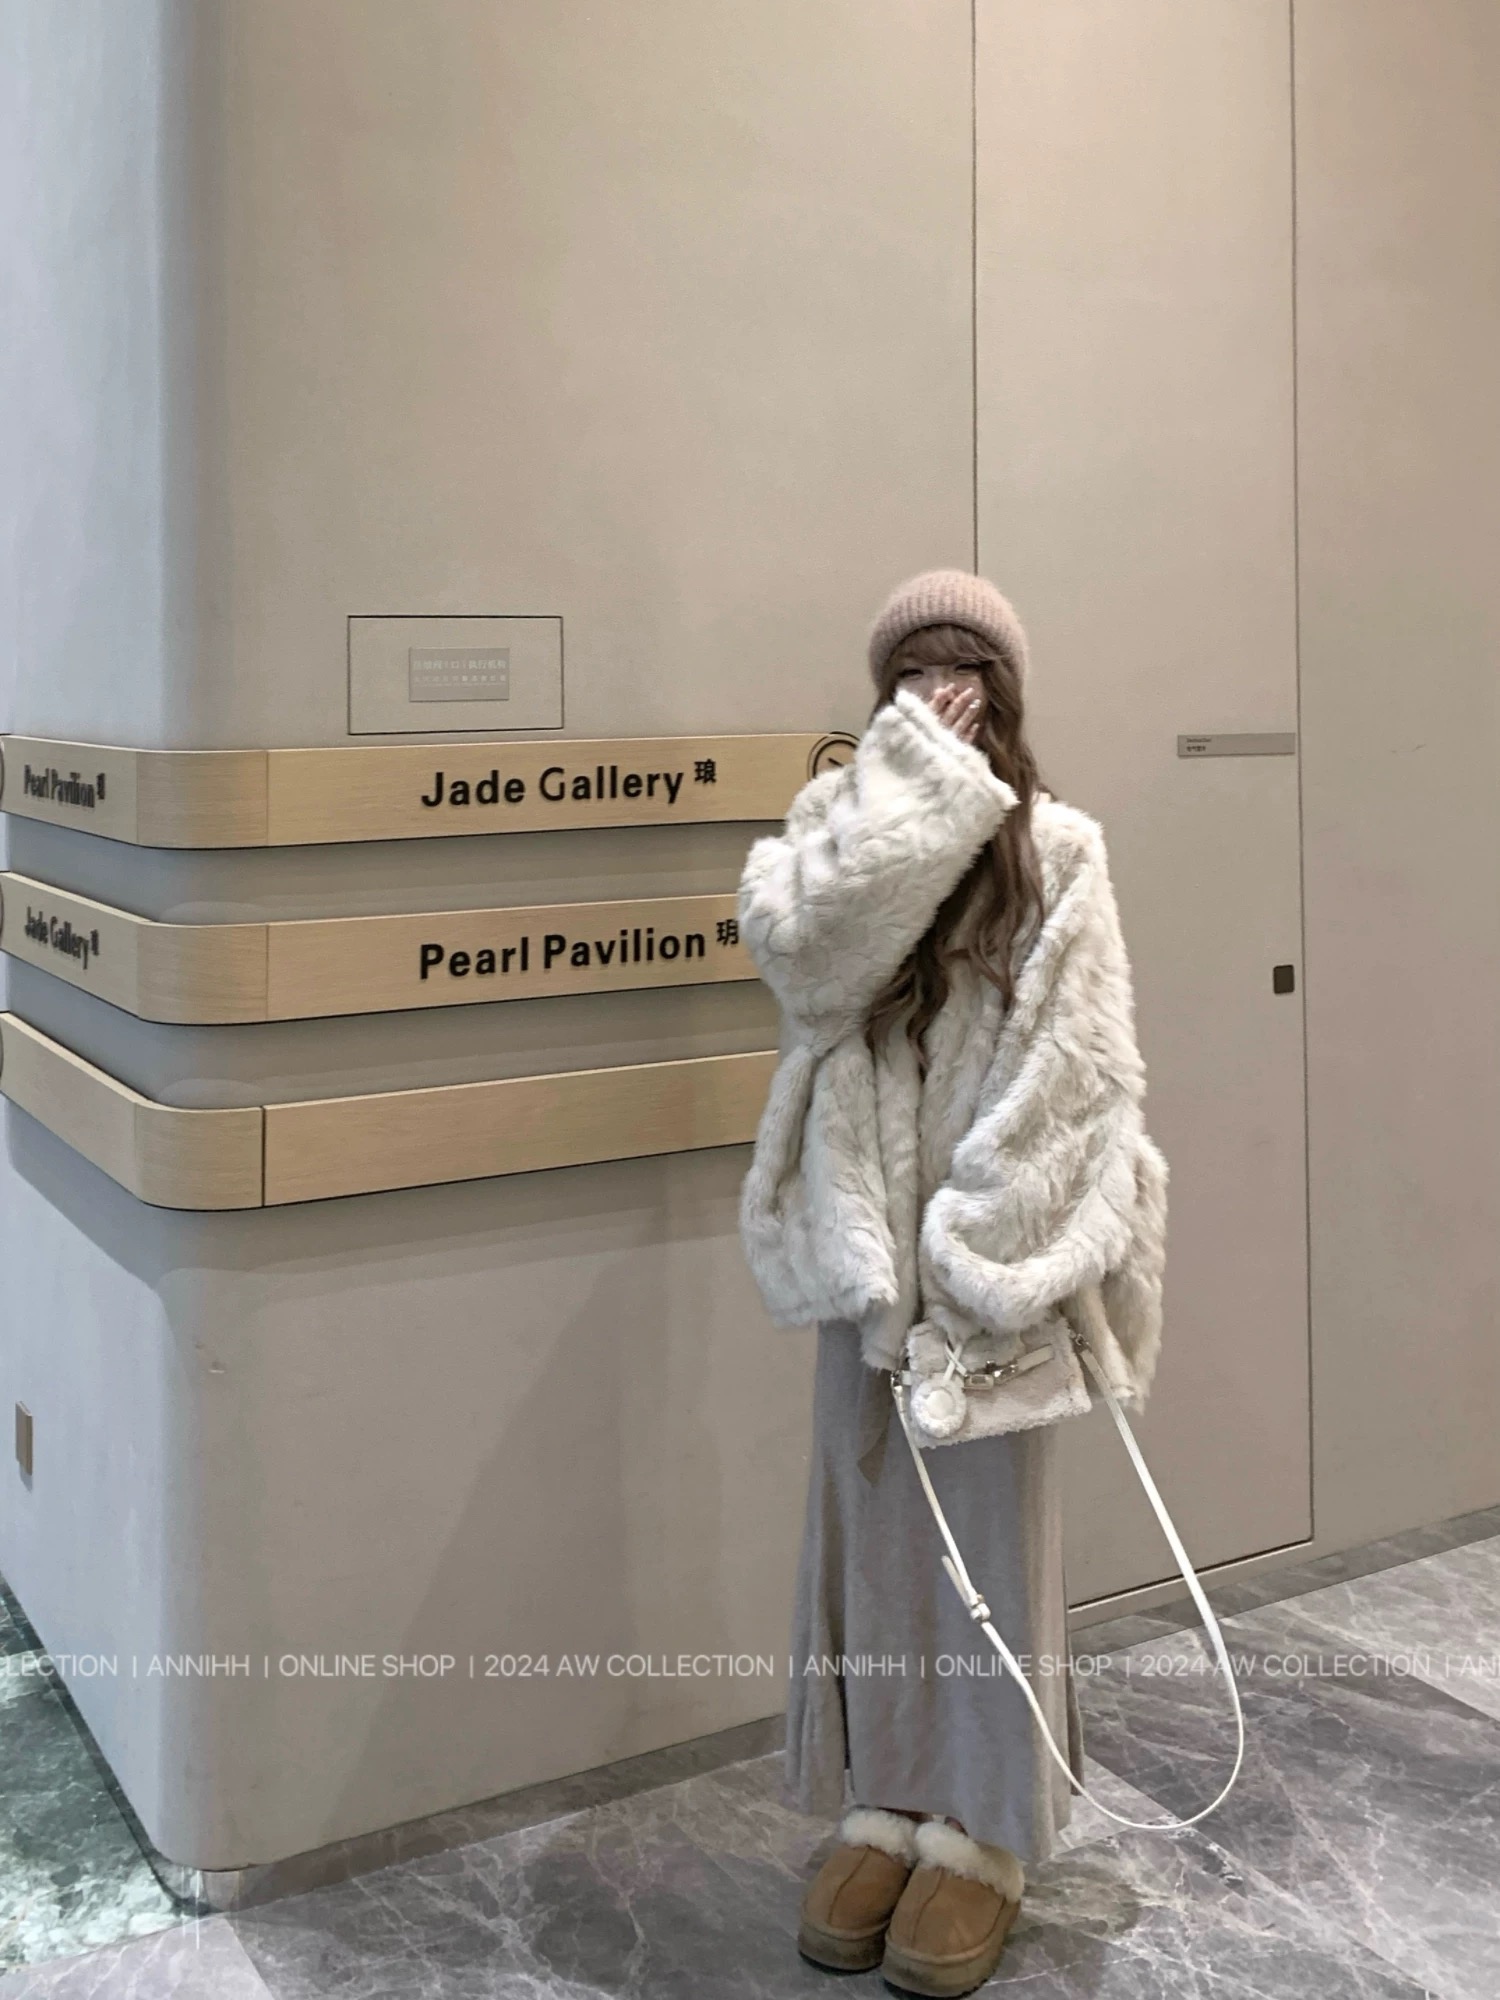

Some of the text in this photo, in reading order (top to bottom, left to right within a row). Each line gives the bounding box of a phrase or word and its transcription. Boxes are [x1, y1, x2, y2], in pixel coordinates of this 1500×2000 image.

[421, 769, 526, 807] Jade
[538, 765, 685, 805] Gallery
[420, 936, 530, 980] Pearl
[543, 927, 706, 969] Pavilion
